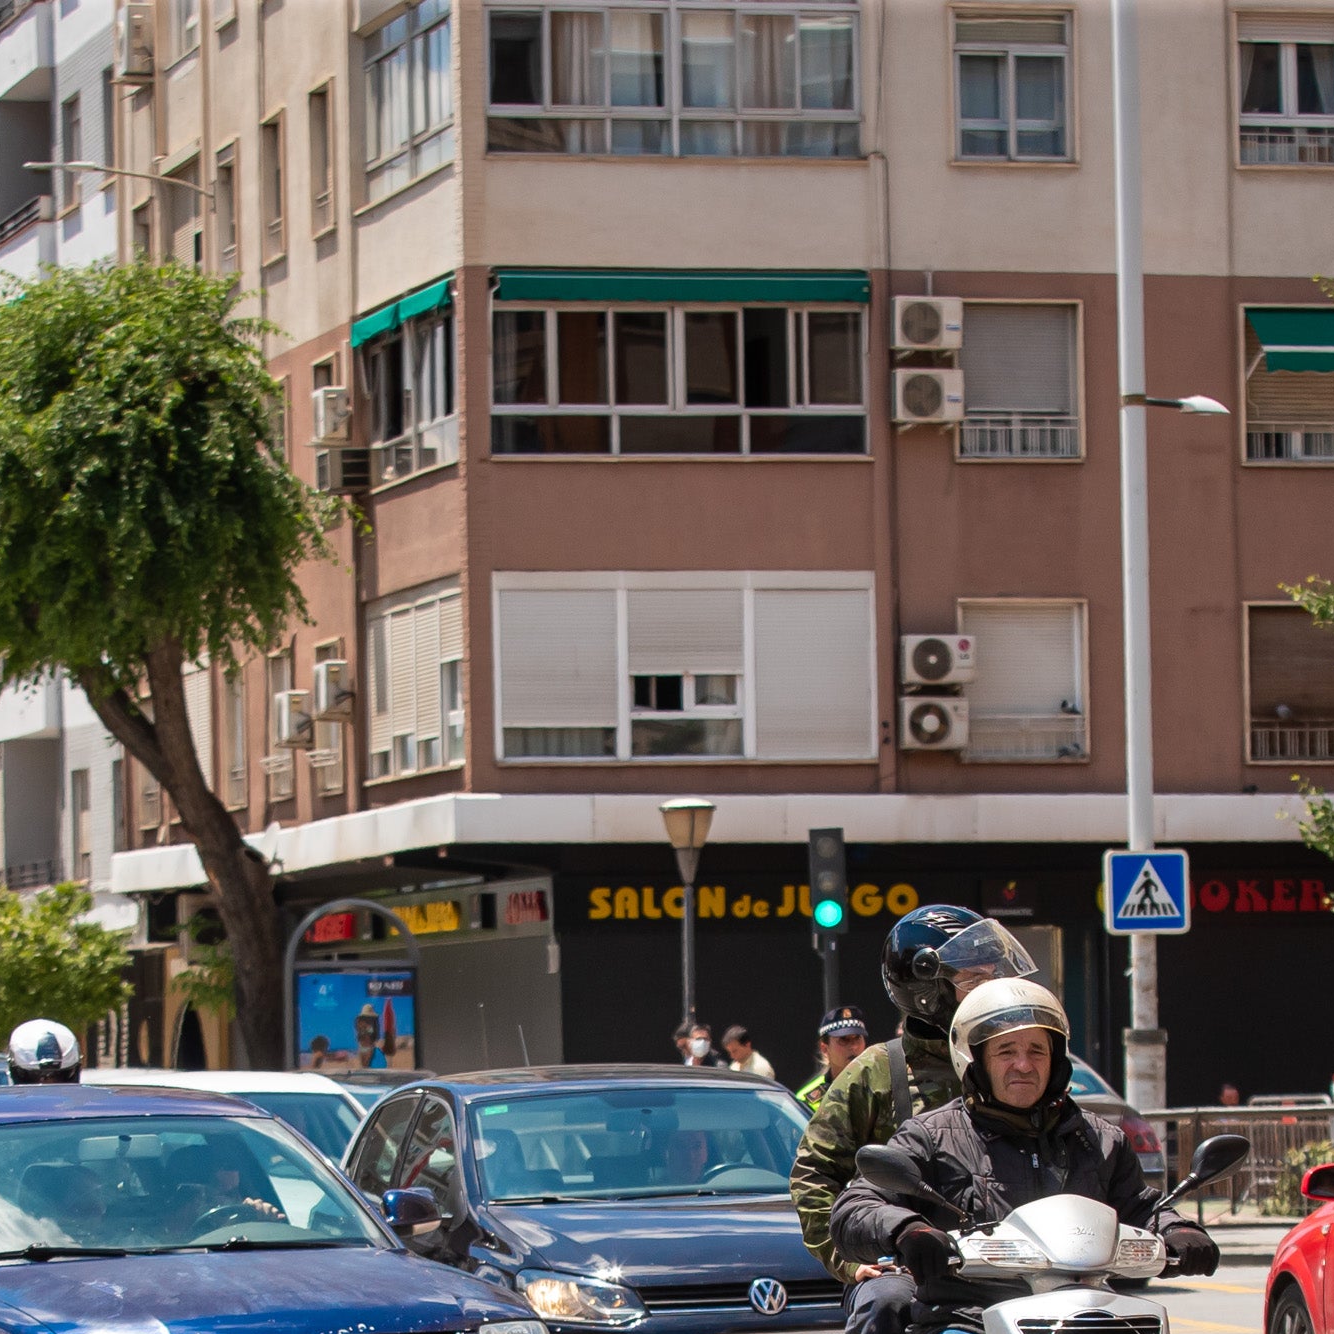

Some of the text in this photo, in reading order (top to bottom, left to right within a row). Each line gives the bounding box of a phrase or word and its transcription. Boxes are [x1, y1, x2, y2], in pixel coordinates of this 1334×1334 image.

[589, 883, 919, 919] SALON de JGO
[1190, 879, 1332, 912] OKER
